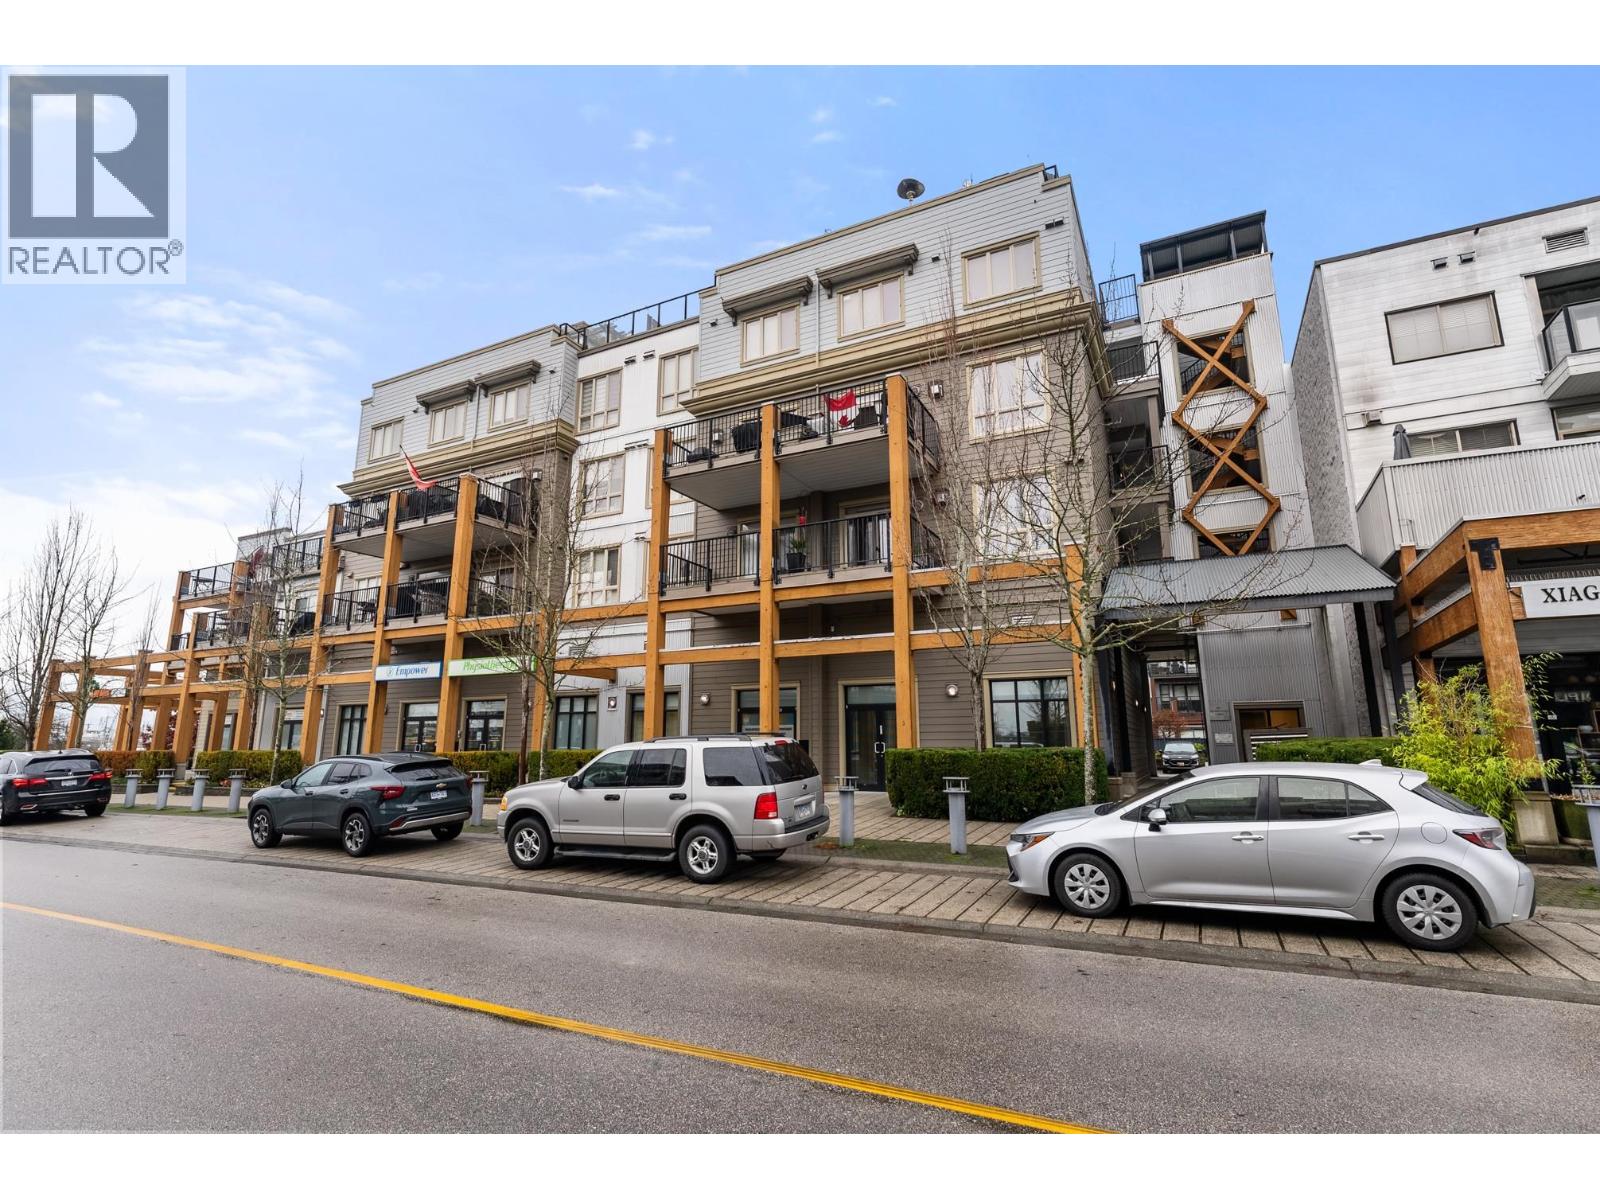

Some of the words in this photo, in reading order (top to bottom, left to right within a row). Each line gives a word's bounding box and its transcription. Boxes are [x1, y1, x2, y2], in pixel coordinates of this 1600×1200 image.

[1540, 584, 1600, 603] XIAG
[395, 665, 429, 678] Empower
[463, 657, 517, 673] Physiothepy
